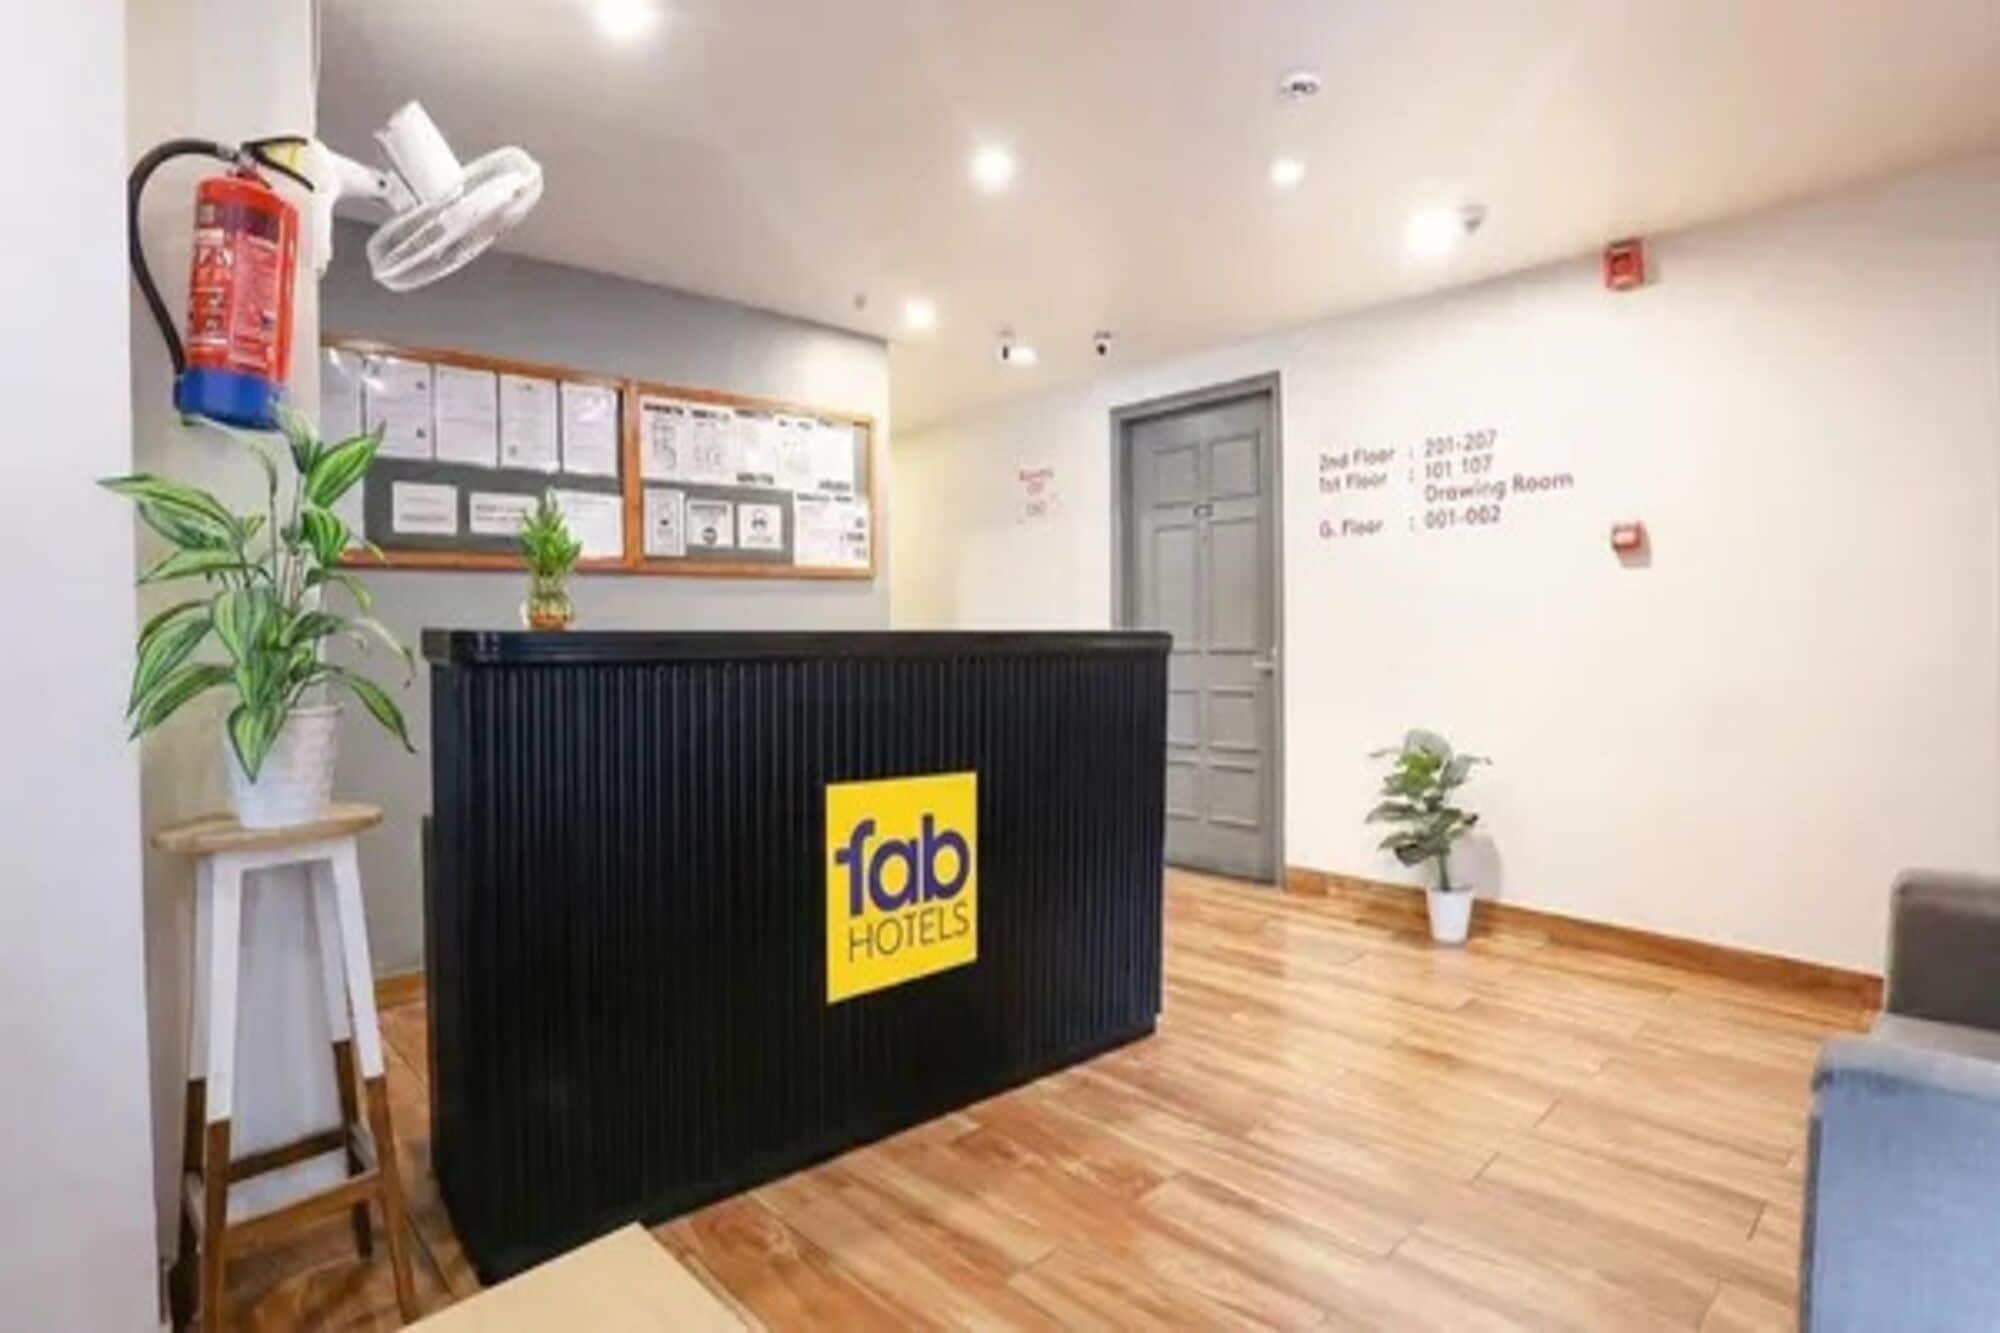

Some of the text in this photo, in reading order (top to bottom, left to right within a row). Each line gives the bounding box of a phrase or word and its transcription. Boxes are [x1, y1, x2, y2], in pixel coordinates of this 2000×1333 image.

[1319, 452, 1350, 472] 2nd
[1352, 447, 1395, 466] Floor
[1425, 428, 1497, 457] 201-207
[1319, 476, 1341, 493] 1st
[1345, 472, 1388, 490] Floor
[1425, 472, 1574, 503] Drawing Room
[1342, 518, 1384, 537] Floor
[1425, 504, 1501, 529] 001-002
[835, 813, 970, 917] fab
[849, 901, 970, 963] HOTELS
